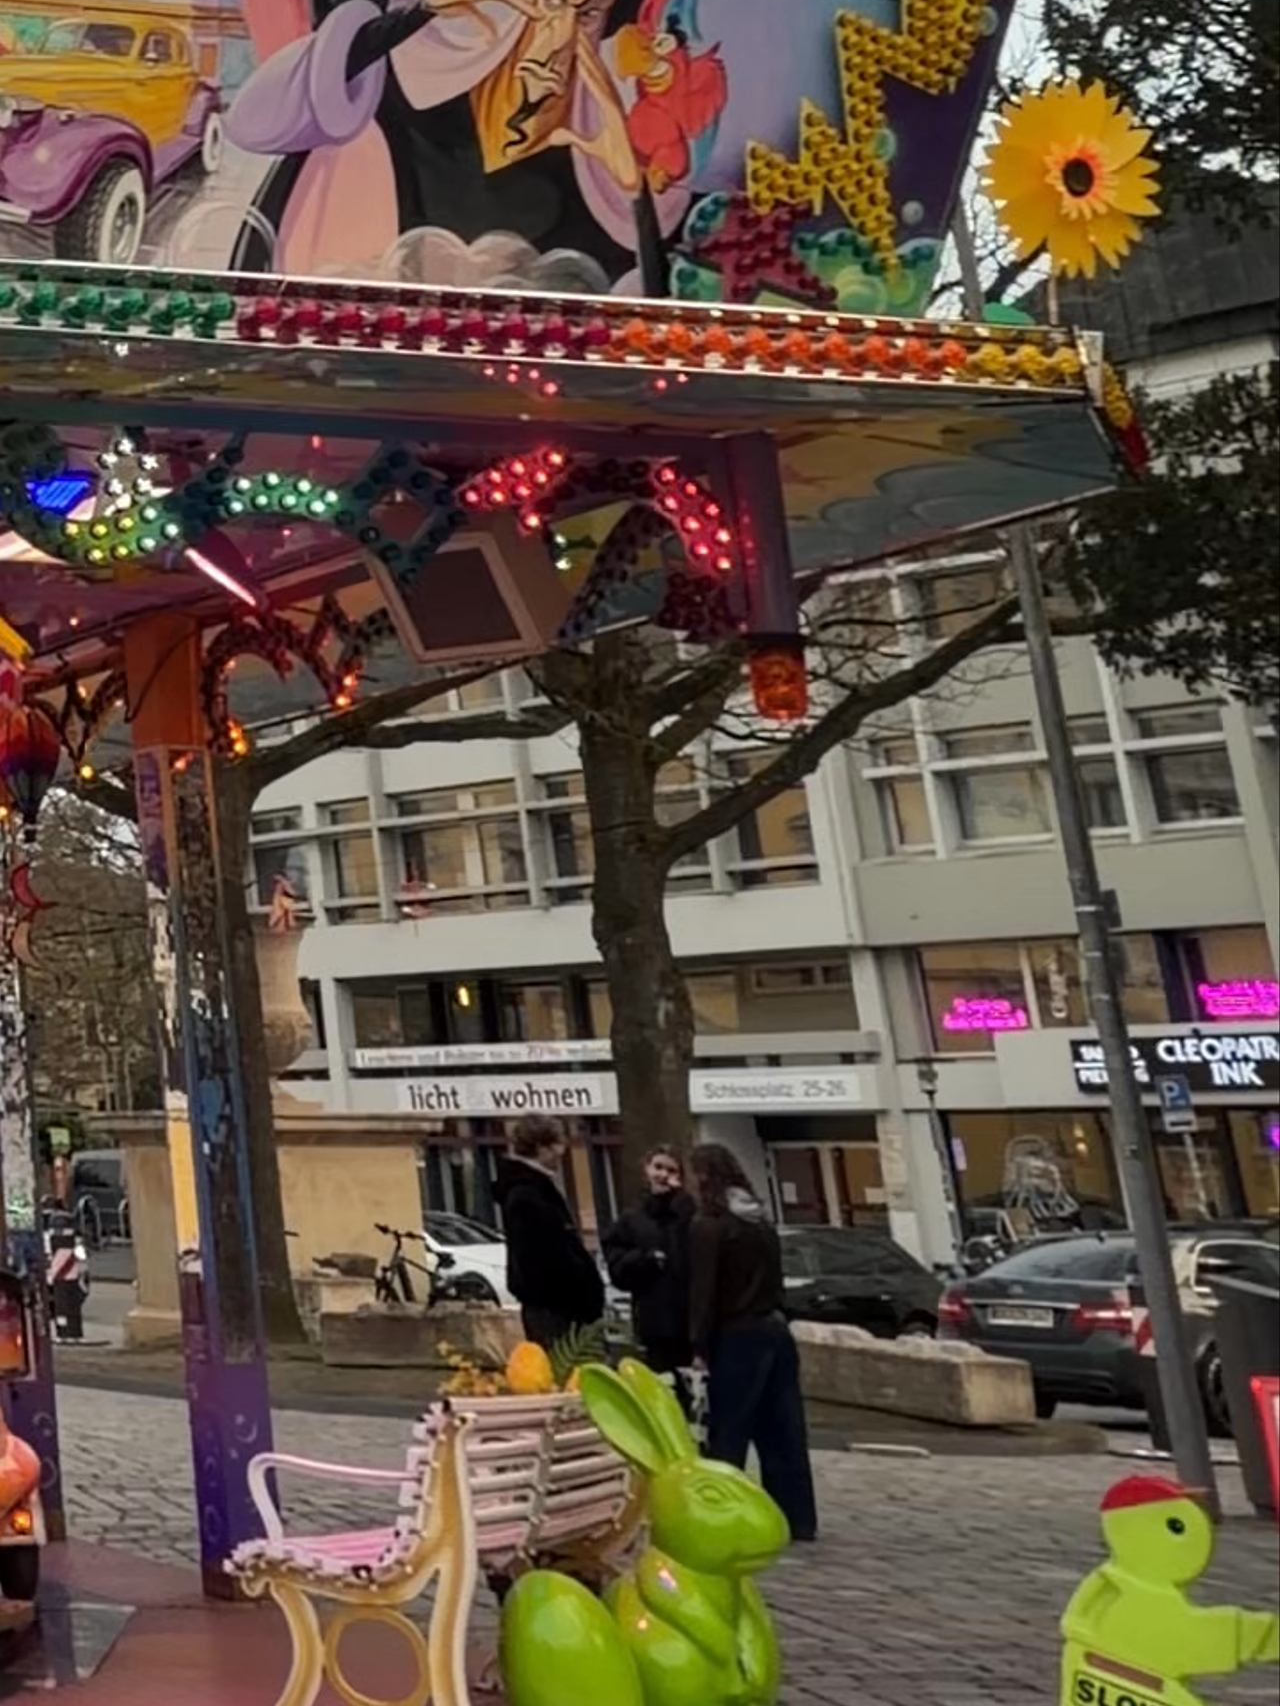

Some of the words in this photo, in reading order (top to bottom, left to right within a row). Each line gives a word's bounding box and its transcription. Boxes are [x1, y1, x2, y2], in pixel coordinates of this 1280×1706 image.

[1210, 1062, 1265, 1086] INK
[407, 1085, 461, 1110] licht
[491, 1083, 591, 1109] wohnen
